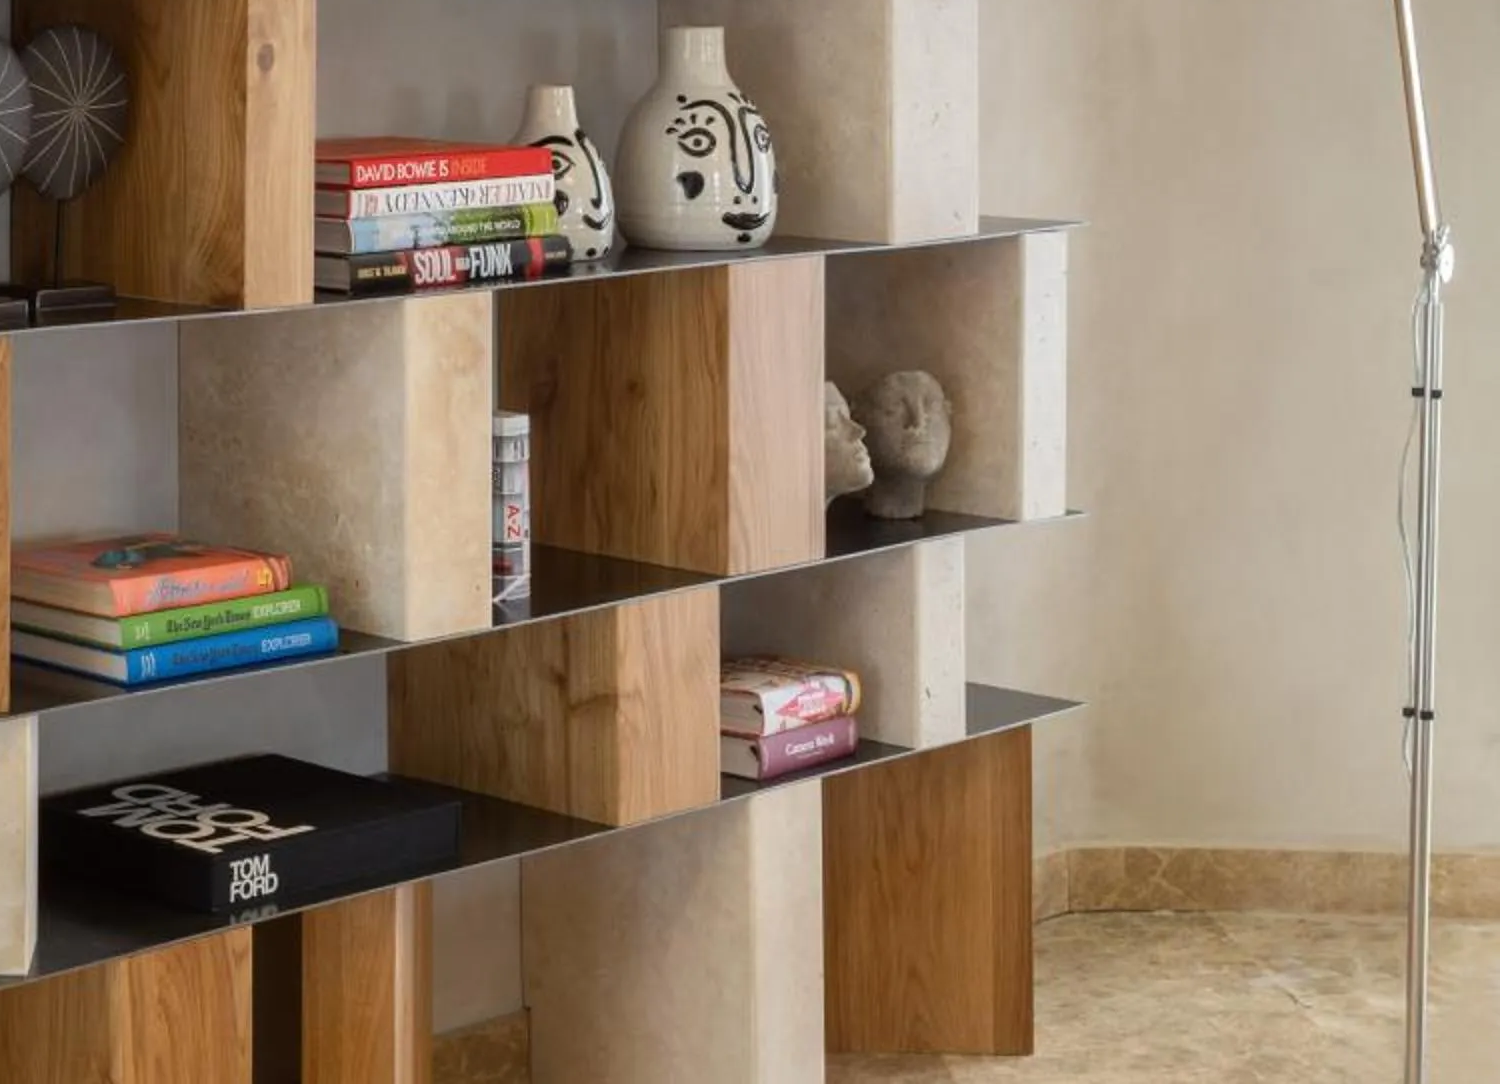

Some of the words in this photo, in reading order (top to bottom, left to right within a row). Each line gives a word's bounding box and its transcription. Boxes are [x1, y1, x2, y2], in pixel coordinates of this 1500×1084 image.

[356, 163, 396, 183] DAVID
[397, 160, 437, 179] BOWIE
[438, 159, 449, 177] IS
[413, 251, 456, 284] SOUL
[469, 243, 514, 279] FUNK
[260, 632, 312, 653] EXPLORER
[111, 782, 317, 842] FORD
[76, 804, 251, 854] TOM
[229, 853, 270, 882] TOM
[229, 872, 279, 904] FORD
